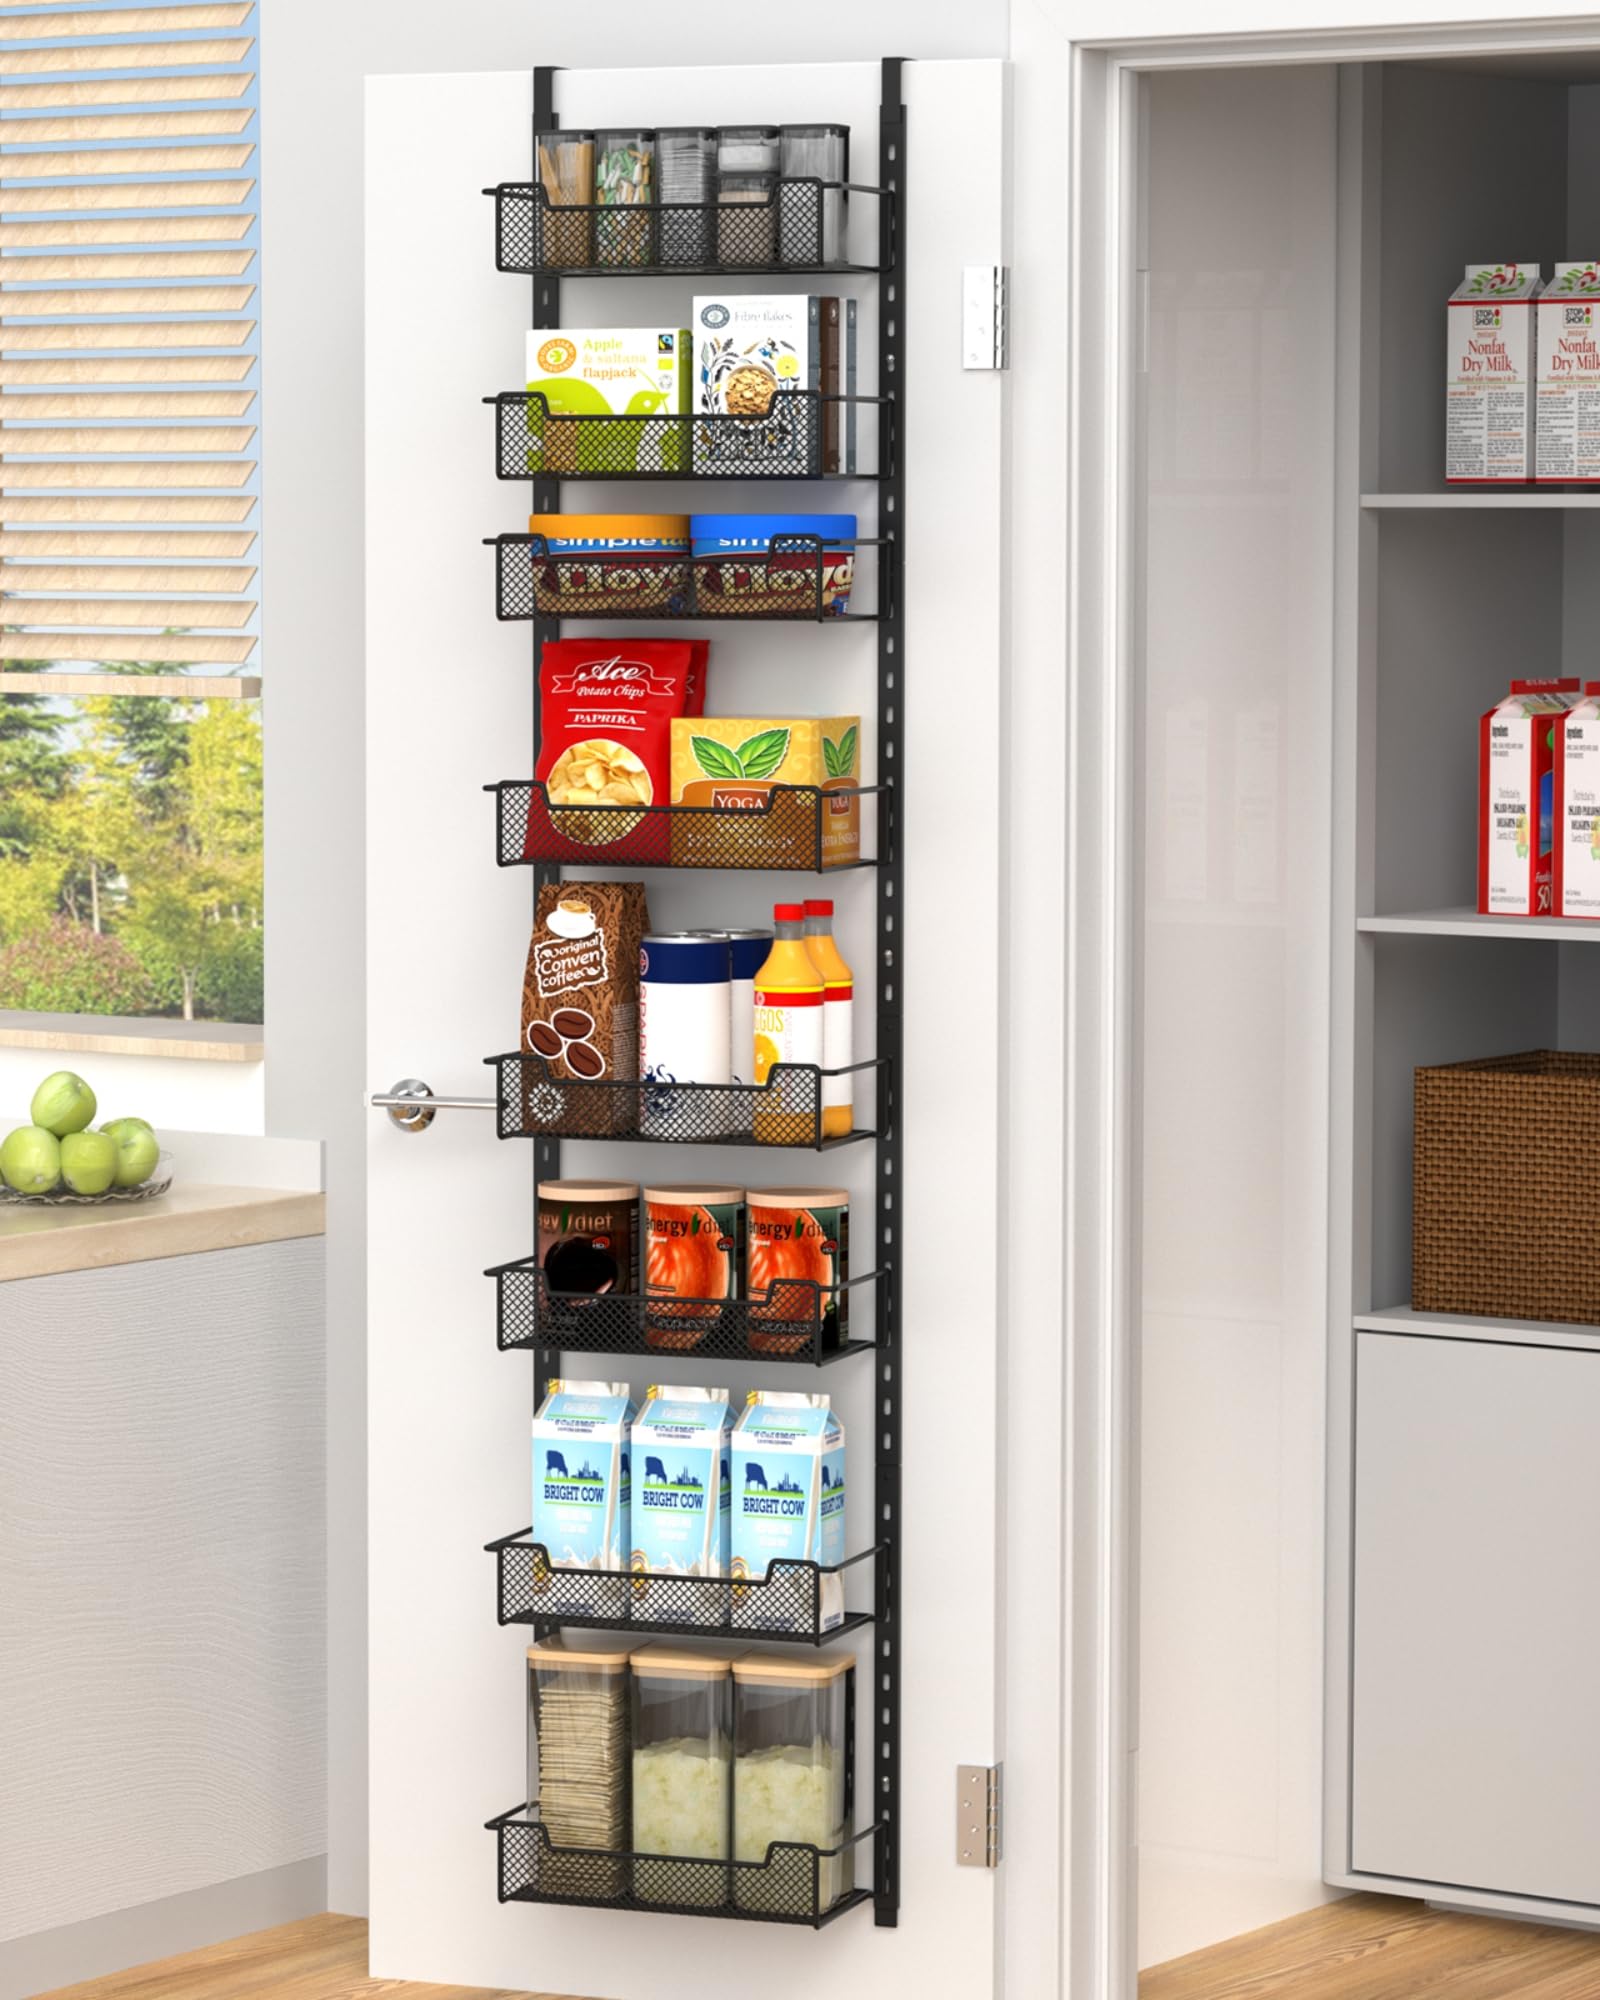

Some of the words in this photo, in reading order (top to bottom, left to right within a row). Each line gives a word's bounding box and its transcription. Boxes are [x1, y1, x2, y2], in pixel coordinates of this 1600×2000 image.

[583, 338, 623, 352] Apple
[1467, 337, 1506, 355] Nonfat
[1558, 336, 1597, 353] Nonfat
[582, 366, 637, 380] flapjack
[1462, 356, 1484, 376] Dry
[1486, 355, 1513, 371] Milk
[1552, 355, 1574, 375] Dry
[578, 655, 647, 681] Ace
[577, 686, 612, 697] Potato
[613, 684, 645, 700] Chips
[573, 713, 637, 725] PAPRIKA
[716, 795, 764, 808] YOGA
[559, 935, 599, 955] original
[540, 950, 600, 975] Conven
[542, 968, 582, 987] coffee
[575, 1211, 613, 1231] diet
[544, 1484, 580, 1502] BRIGHT
[581, 1488, 605, 1503] COW
[642, 1490, 679, 1508] BRIGHT
[680, 1493, 704, 1510] COW
[743, 1497, 779, 1515] BRIGHT
[781, 1500, 805, 1517] COW
